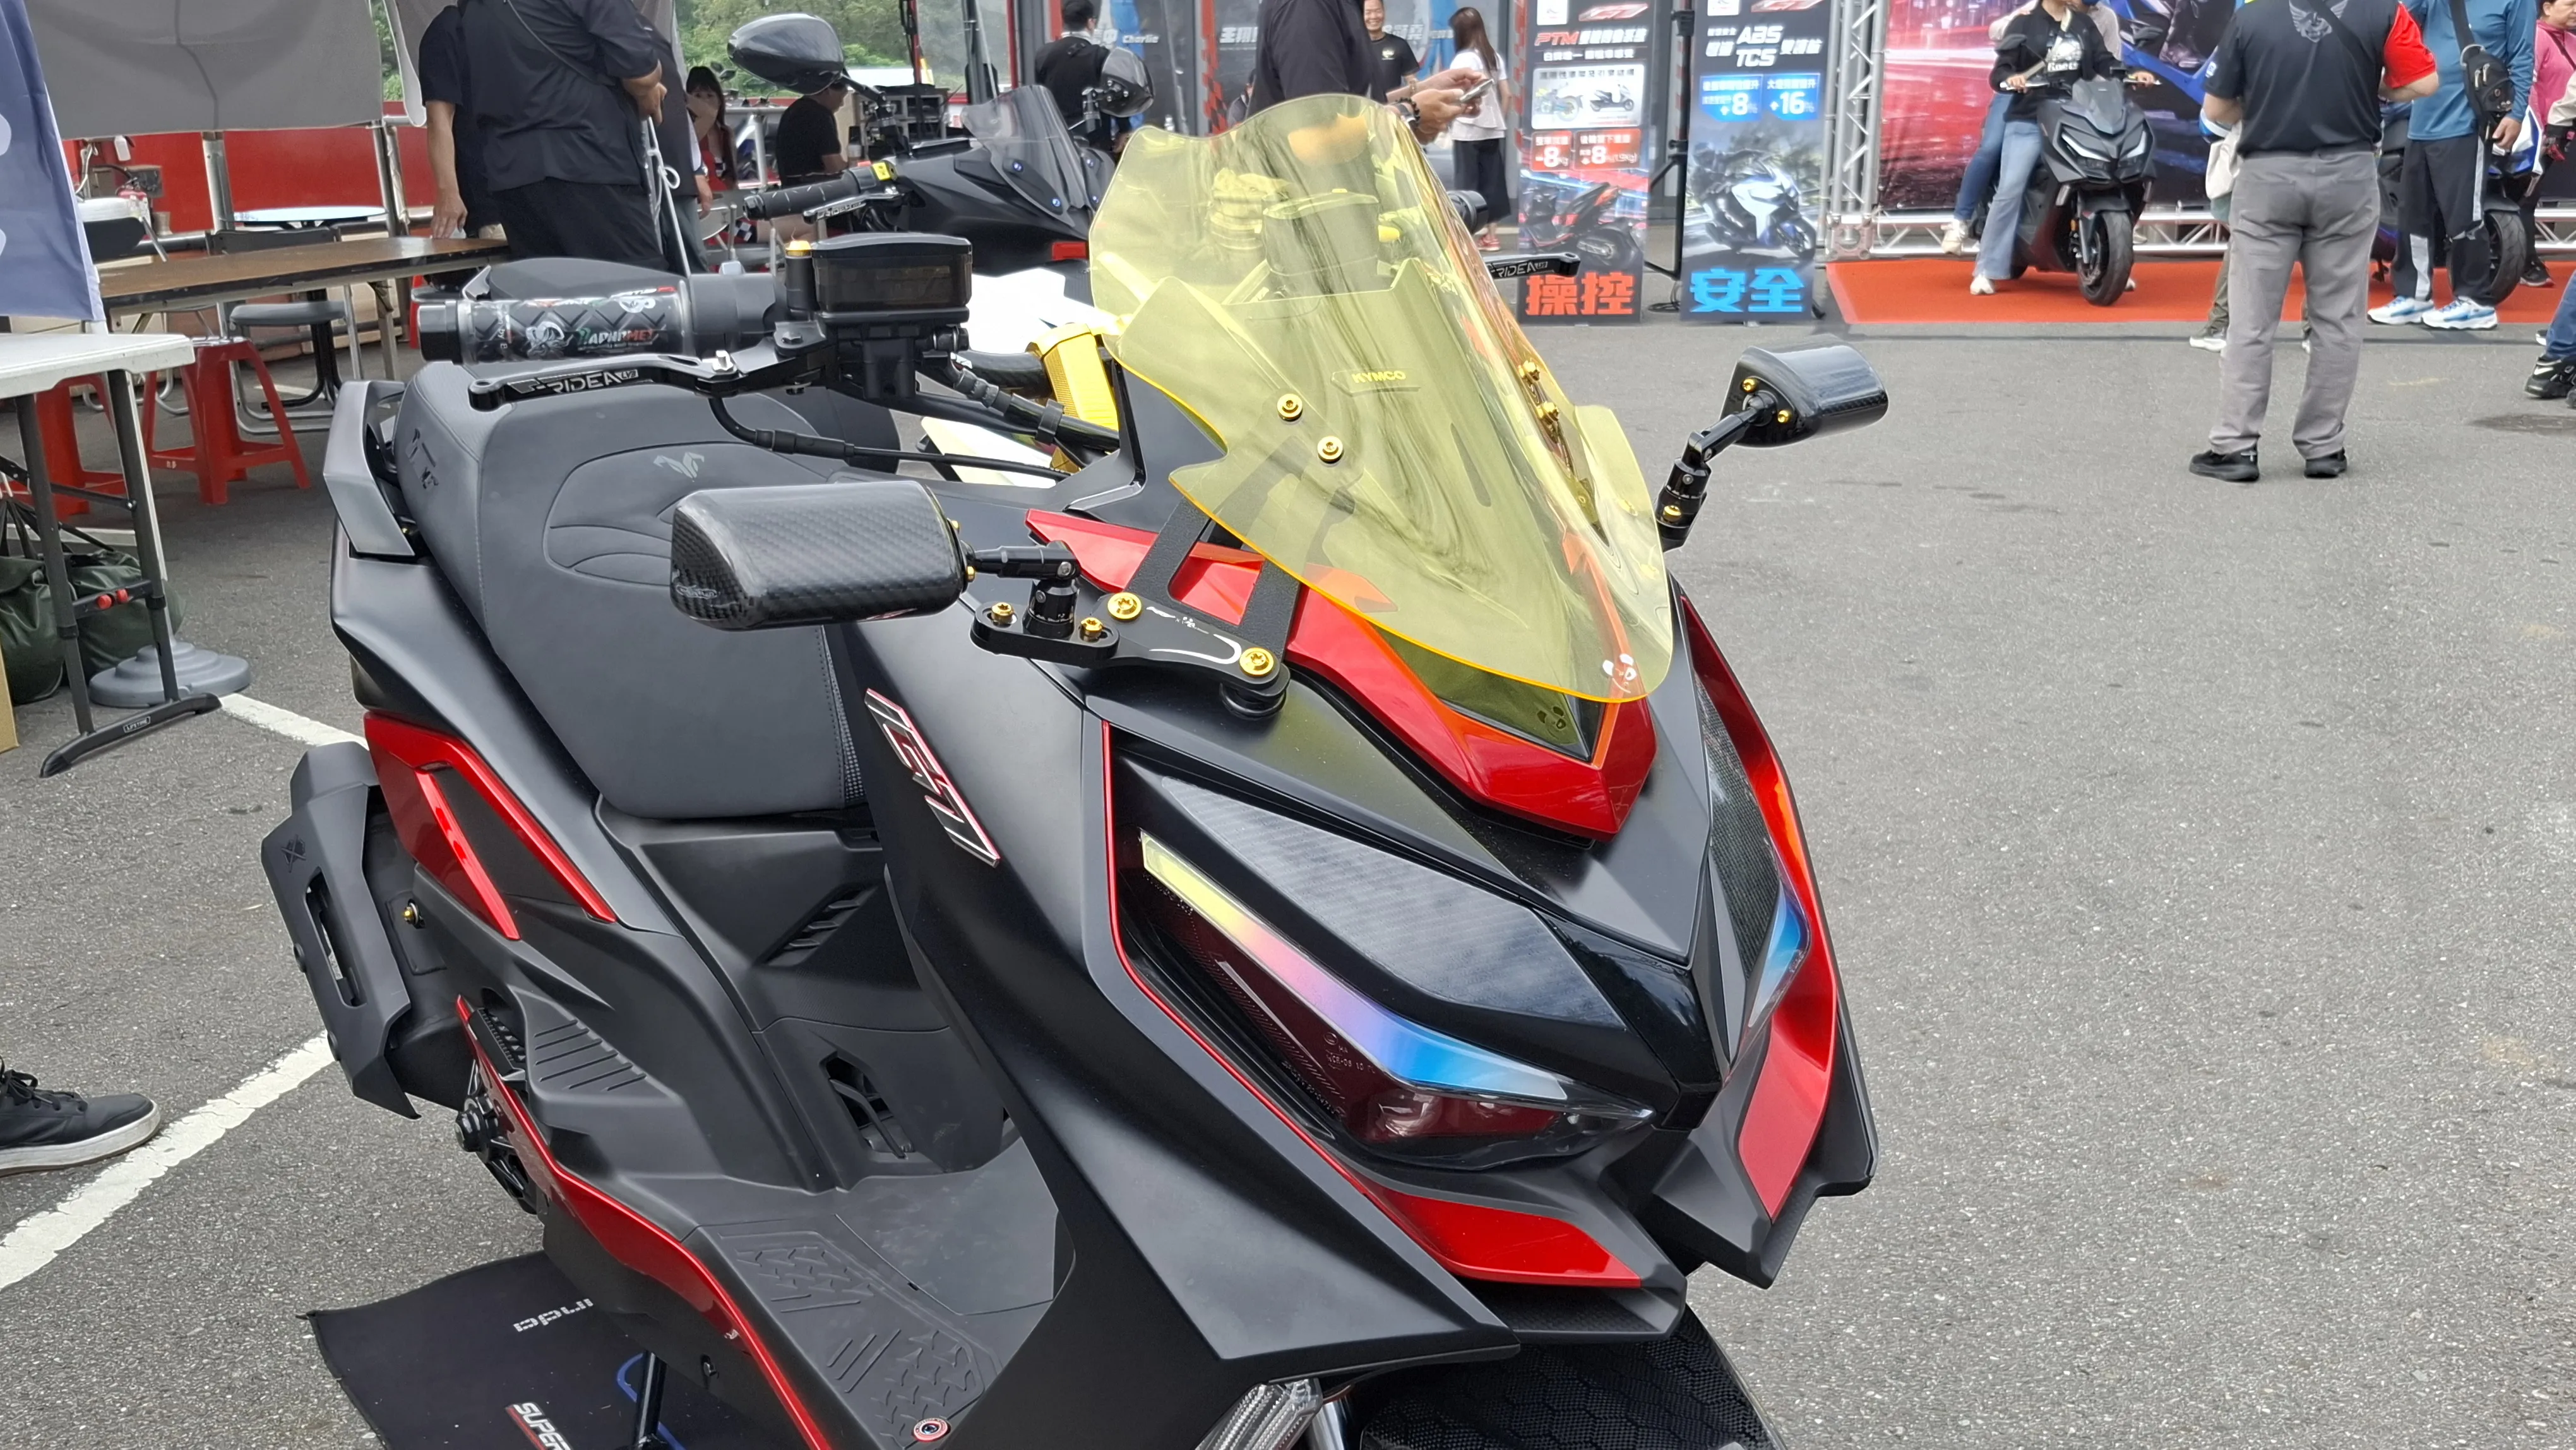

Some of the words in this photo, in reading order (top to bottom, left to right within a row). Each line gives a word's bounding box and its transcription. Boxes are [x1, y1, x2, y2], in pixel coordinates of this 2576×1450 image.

[1534, 32, 1578, 46] PTM
[1737, 26, 1784, 44] ABS
[1736, 49, 1777, 67] TCS
[1496, 261, 1536, 277] RIDEA
[1525, 272, 1634, 315] 操控
[1690, 268, 1804, 313] 安全
[548, 370, 623, 394] RIDEA
[1351, 370, 1407, 383] KYMCO
